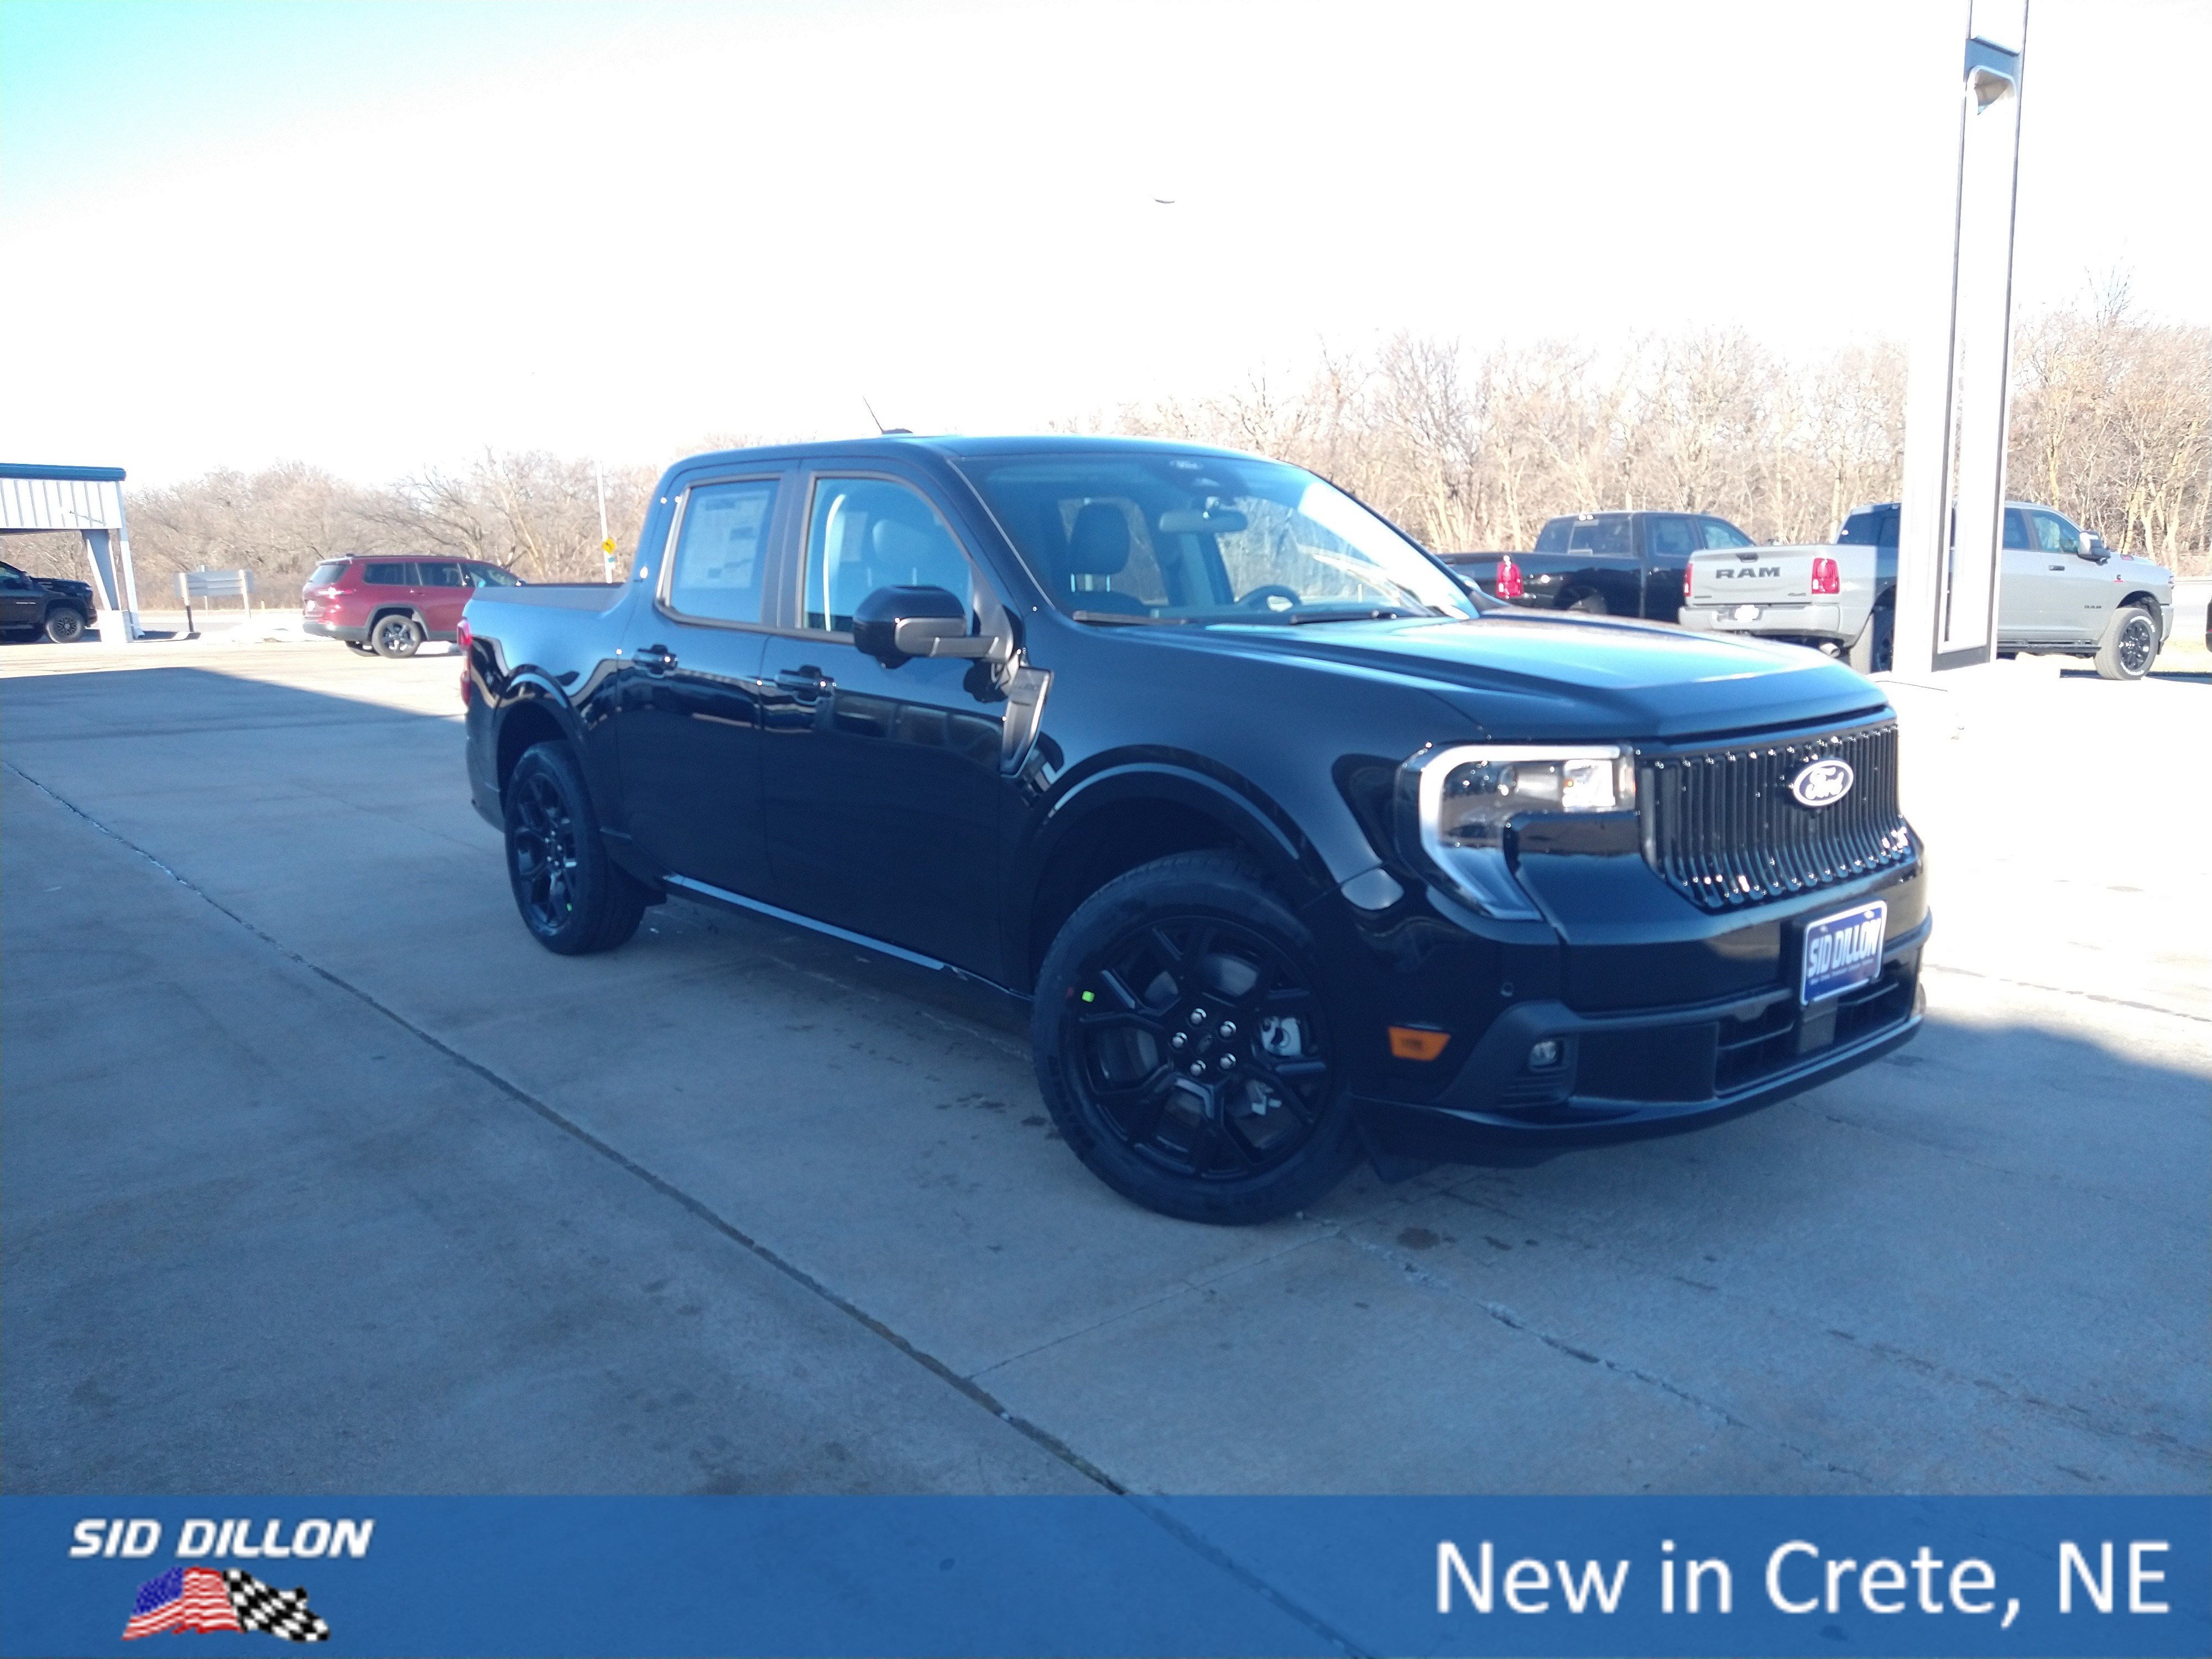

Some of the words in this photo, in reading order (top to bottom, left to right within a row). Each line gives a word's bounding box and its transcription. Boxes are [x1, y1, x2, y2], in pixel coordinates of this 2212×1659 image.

[1716, 567, 1780, 579] RAM
[1808, 934, 1833, 978] SID
[1832, 917, 1882, 969] DILLON
